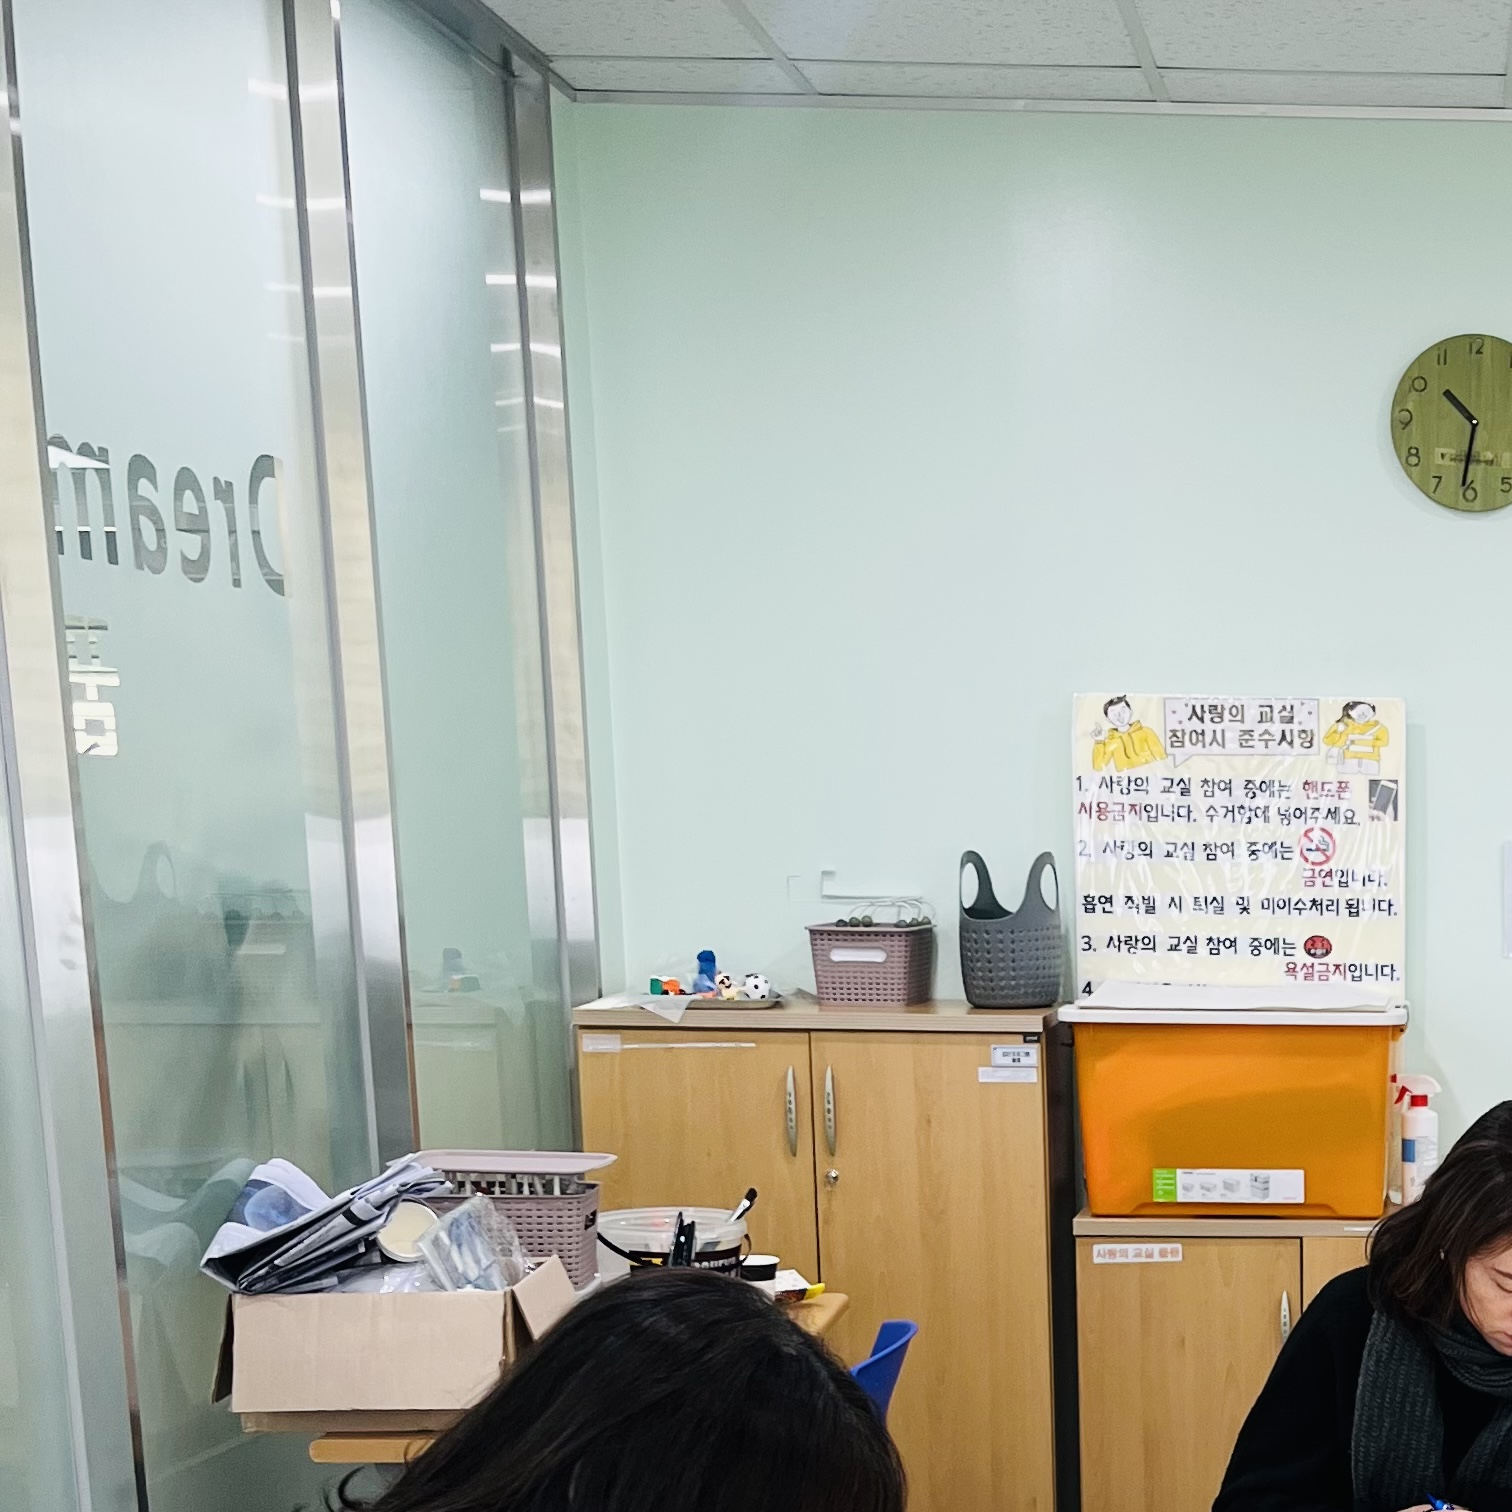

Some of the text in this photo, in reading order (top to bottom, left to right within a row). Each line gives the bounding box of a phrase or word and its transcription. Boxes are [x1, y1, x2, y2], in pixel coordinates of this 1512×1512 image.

[1469, 338, 1484, 355] 12
[1437, 349, 1447, 366] 11
[1399, 408, 1413, 430] 9
[1405, 446, 1421, 467] 8
[1432, 476, 1442, 494] 7
[1462, 479, 1478, 503] 6
[1500, 476, 1512, 493] 5
[1188, 704, 1295, 724] 사랑의 교실
[1169, 729, 1315, 749] 참여시 준수사항
[1076, 776, 1351, 799] 1. 사랑의 교실 참여 중에는 핸드폰
[1078, 801, 1360, 826] 사용금지입니다. 수거함에 넣어주세요.
[1103, 841, 1153, 859] 사랑의
[1164, 842, 1196, 861] 교실
[1203, 842, 1234, 860] 참여
[1247, 842, 1294, 861] 중에는
[1302, 869, 1387, 888] 금연입니다.
[1082, 895, 1113, 913] 흡연
[1125, 895, 1156, 914] 적발
[1168, 896, 1182, 914] 시
[1193, 896, 1224, 915] 퇴실
[1236, 897, 1251, 915] 및
[1082, 935, 1296, 956] 3. 사랑의 교실 참여 중에는
[1285, 963, 1400, 981] 욕설금지입니다.
